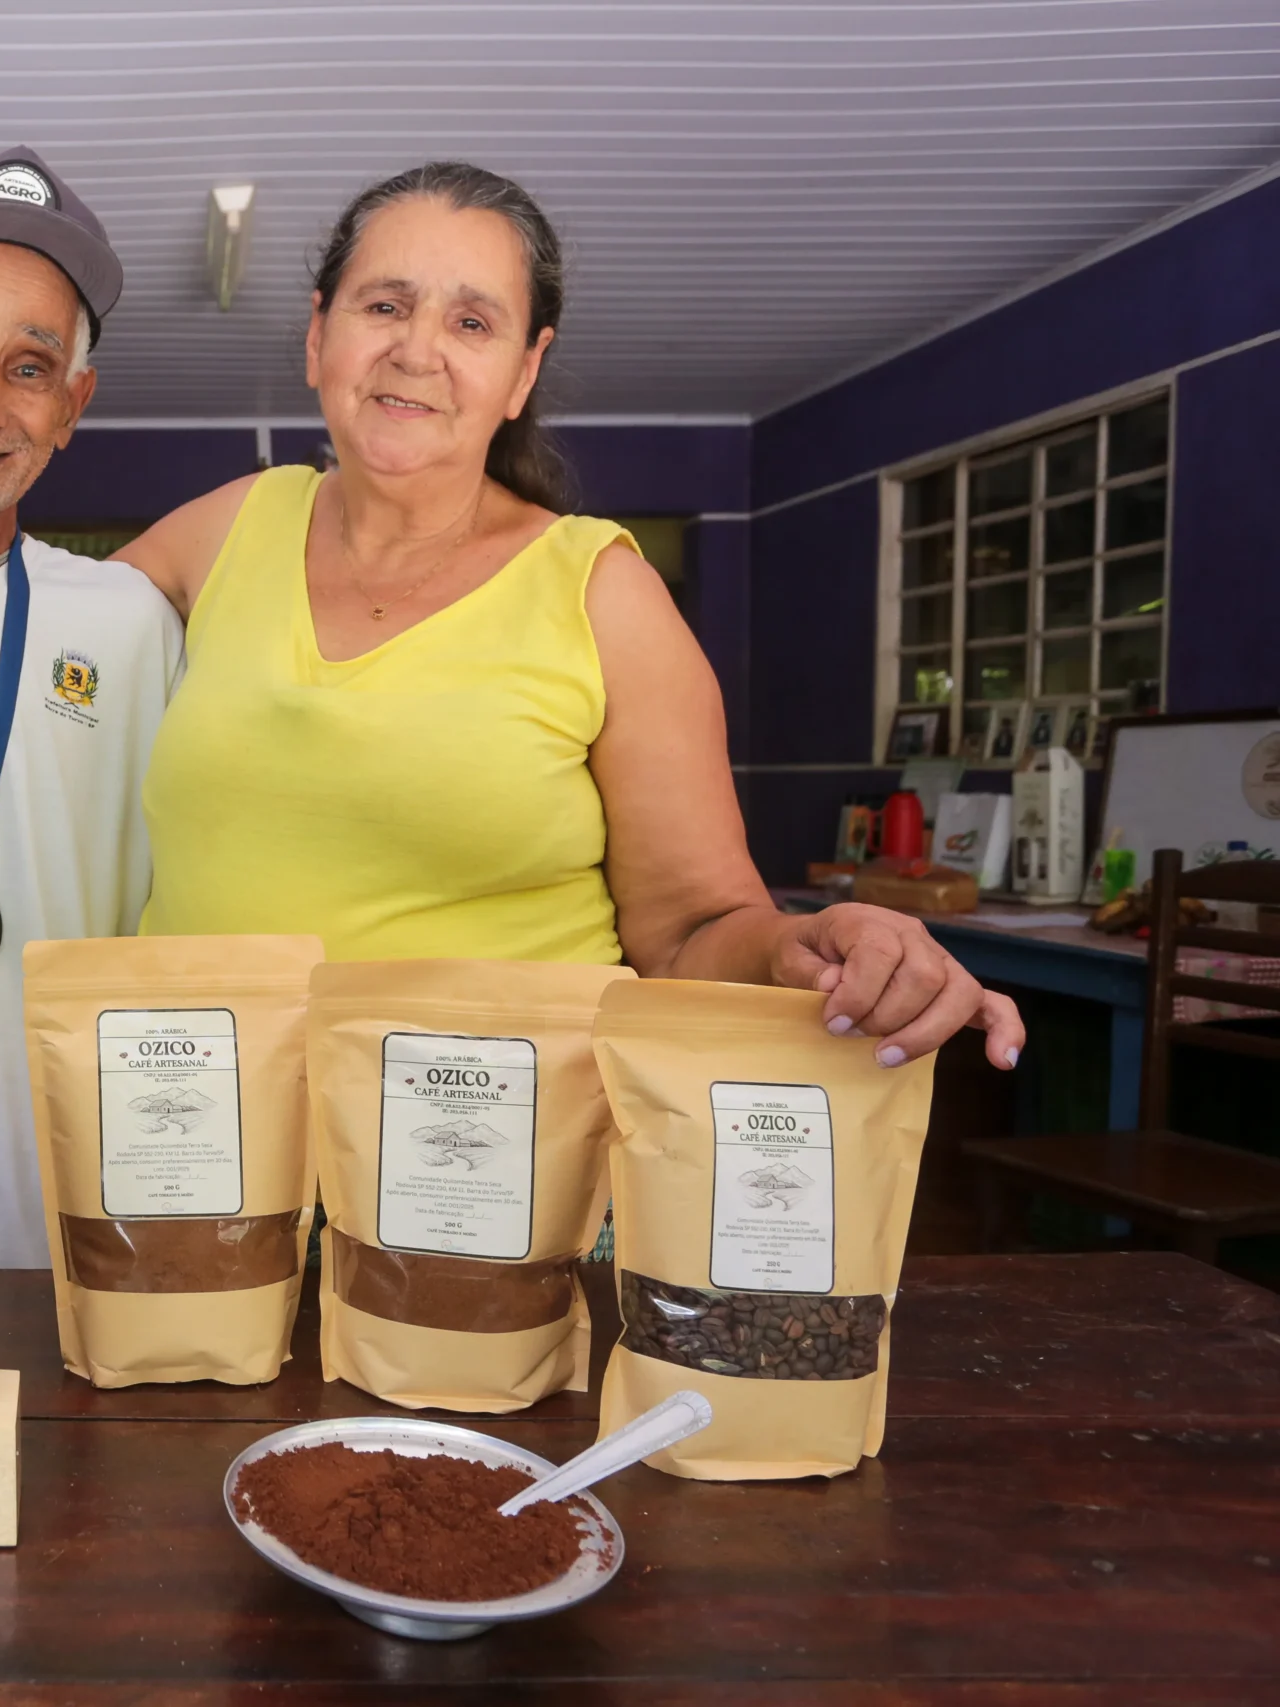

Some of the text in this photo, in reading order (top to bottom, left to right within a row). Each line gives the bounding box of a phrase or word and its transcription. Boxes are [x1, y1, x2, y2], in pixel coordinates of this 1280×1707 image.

[138, 1040, 196, 1056] OZICO
[128, 1058, 208, 1068] CAFÉ ARTESANAL
[426, 1068, 490, 1087] OZICO
[414, 1086, 502, 1101] CAFÉ ARTESANAL
[747, 1114, 796, 1131] OZICO
[739, 1132, 807, 1144] CAFÉ ARTESANAL
[409, 1175, 442, 1183] Comunidade
[474, 1179, 488, 1187] Terra
